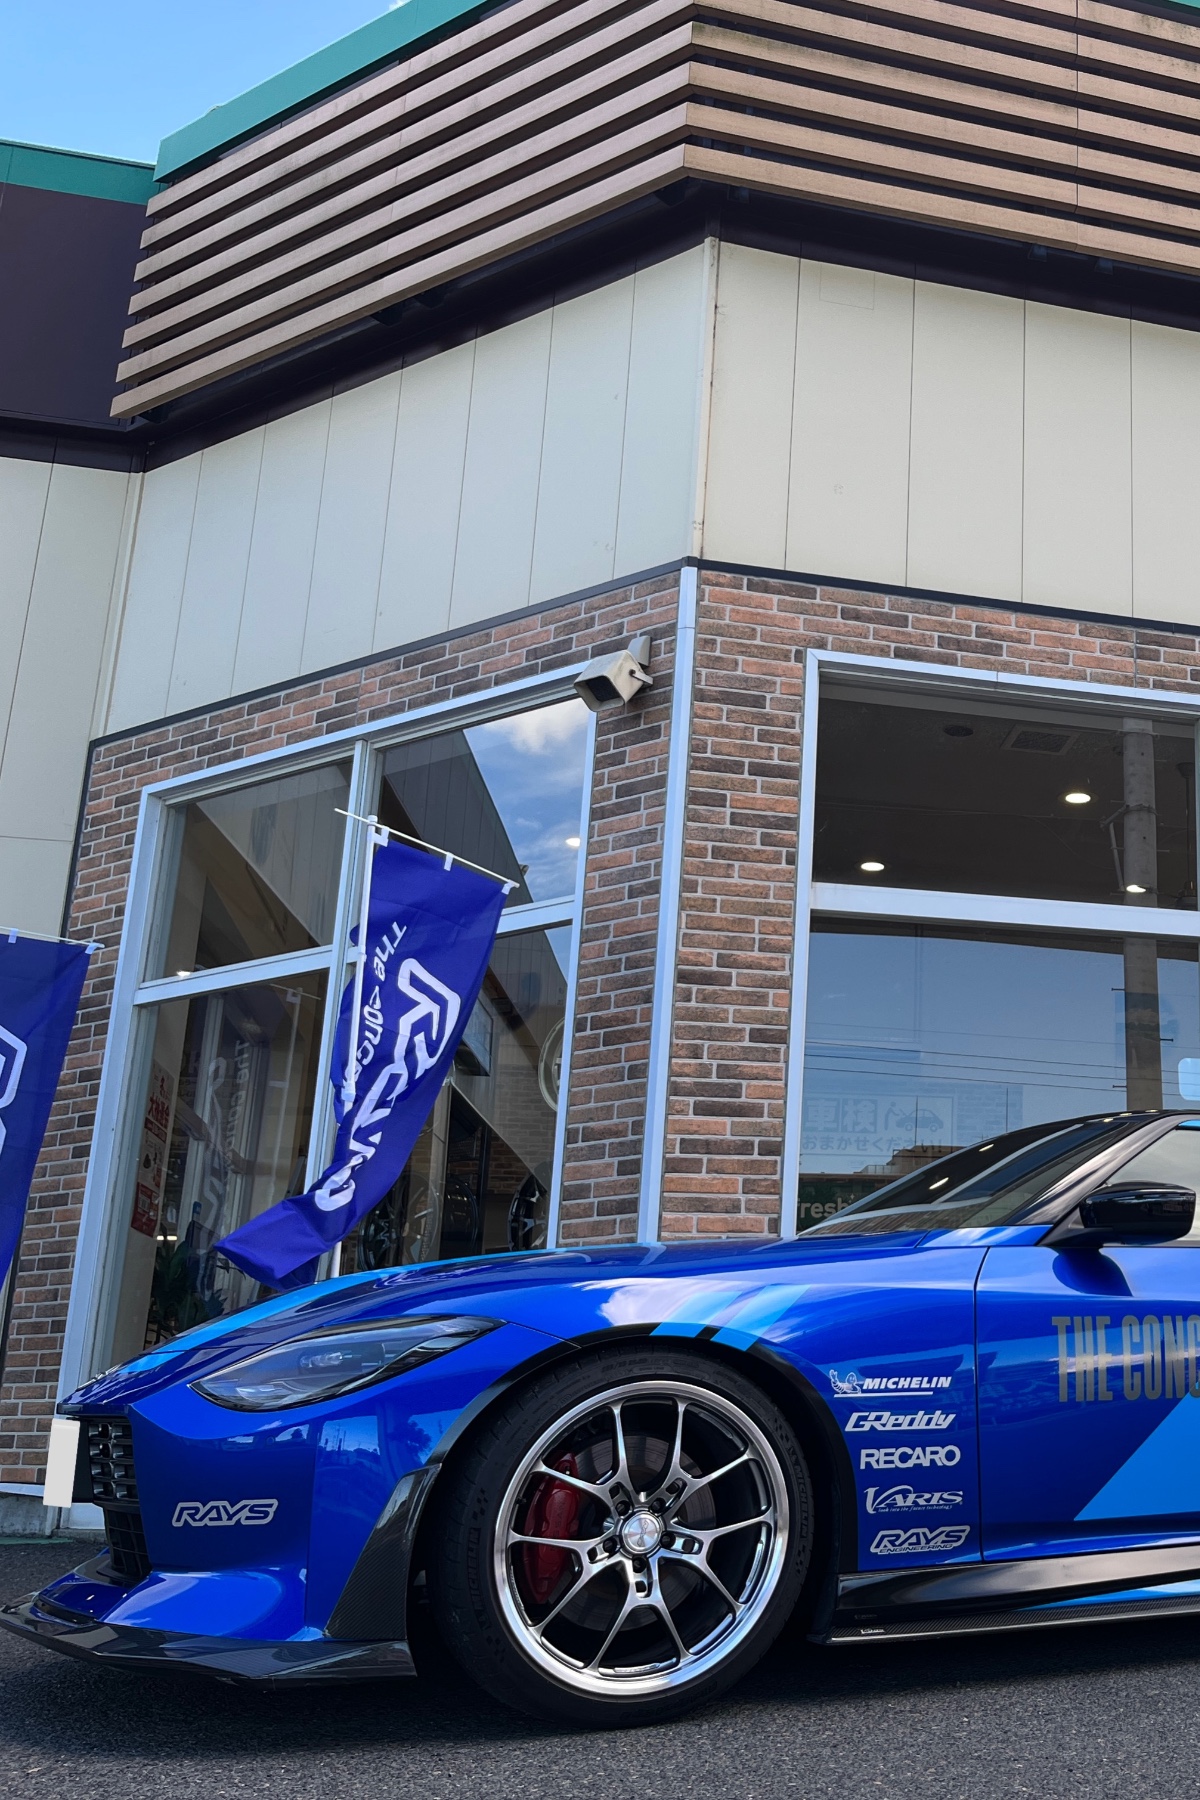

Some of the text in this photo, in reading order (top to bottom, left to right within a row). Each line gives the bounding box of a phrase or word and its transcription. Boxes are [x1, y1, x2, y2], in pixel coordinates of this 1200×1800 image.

[803, 1099, 877, 1133] 車検
[797, 1197, 849, 1219] resh
[1051, 1315, 1113, 1403] THE
[862, 1376, 953, 1390] MICHELIN
[860, 1445, 962, 1470] RECARO
[171, 1499, 279, 1527] RAYS
[870, 1525, 971, 1552] RAYS
[879, 1543, 954, 1555] ENGINEERING
